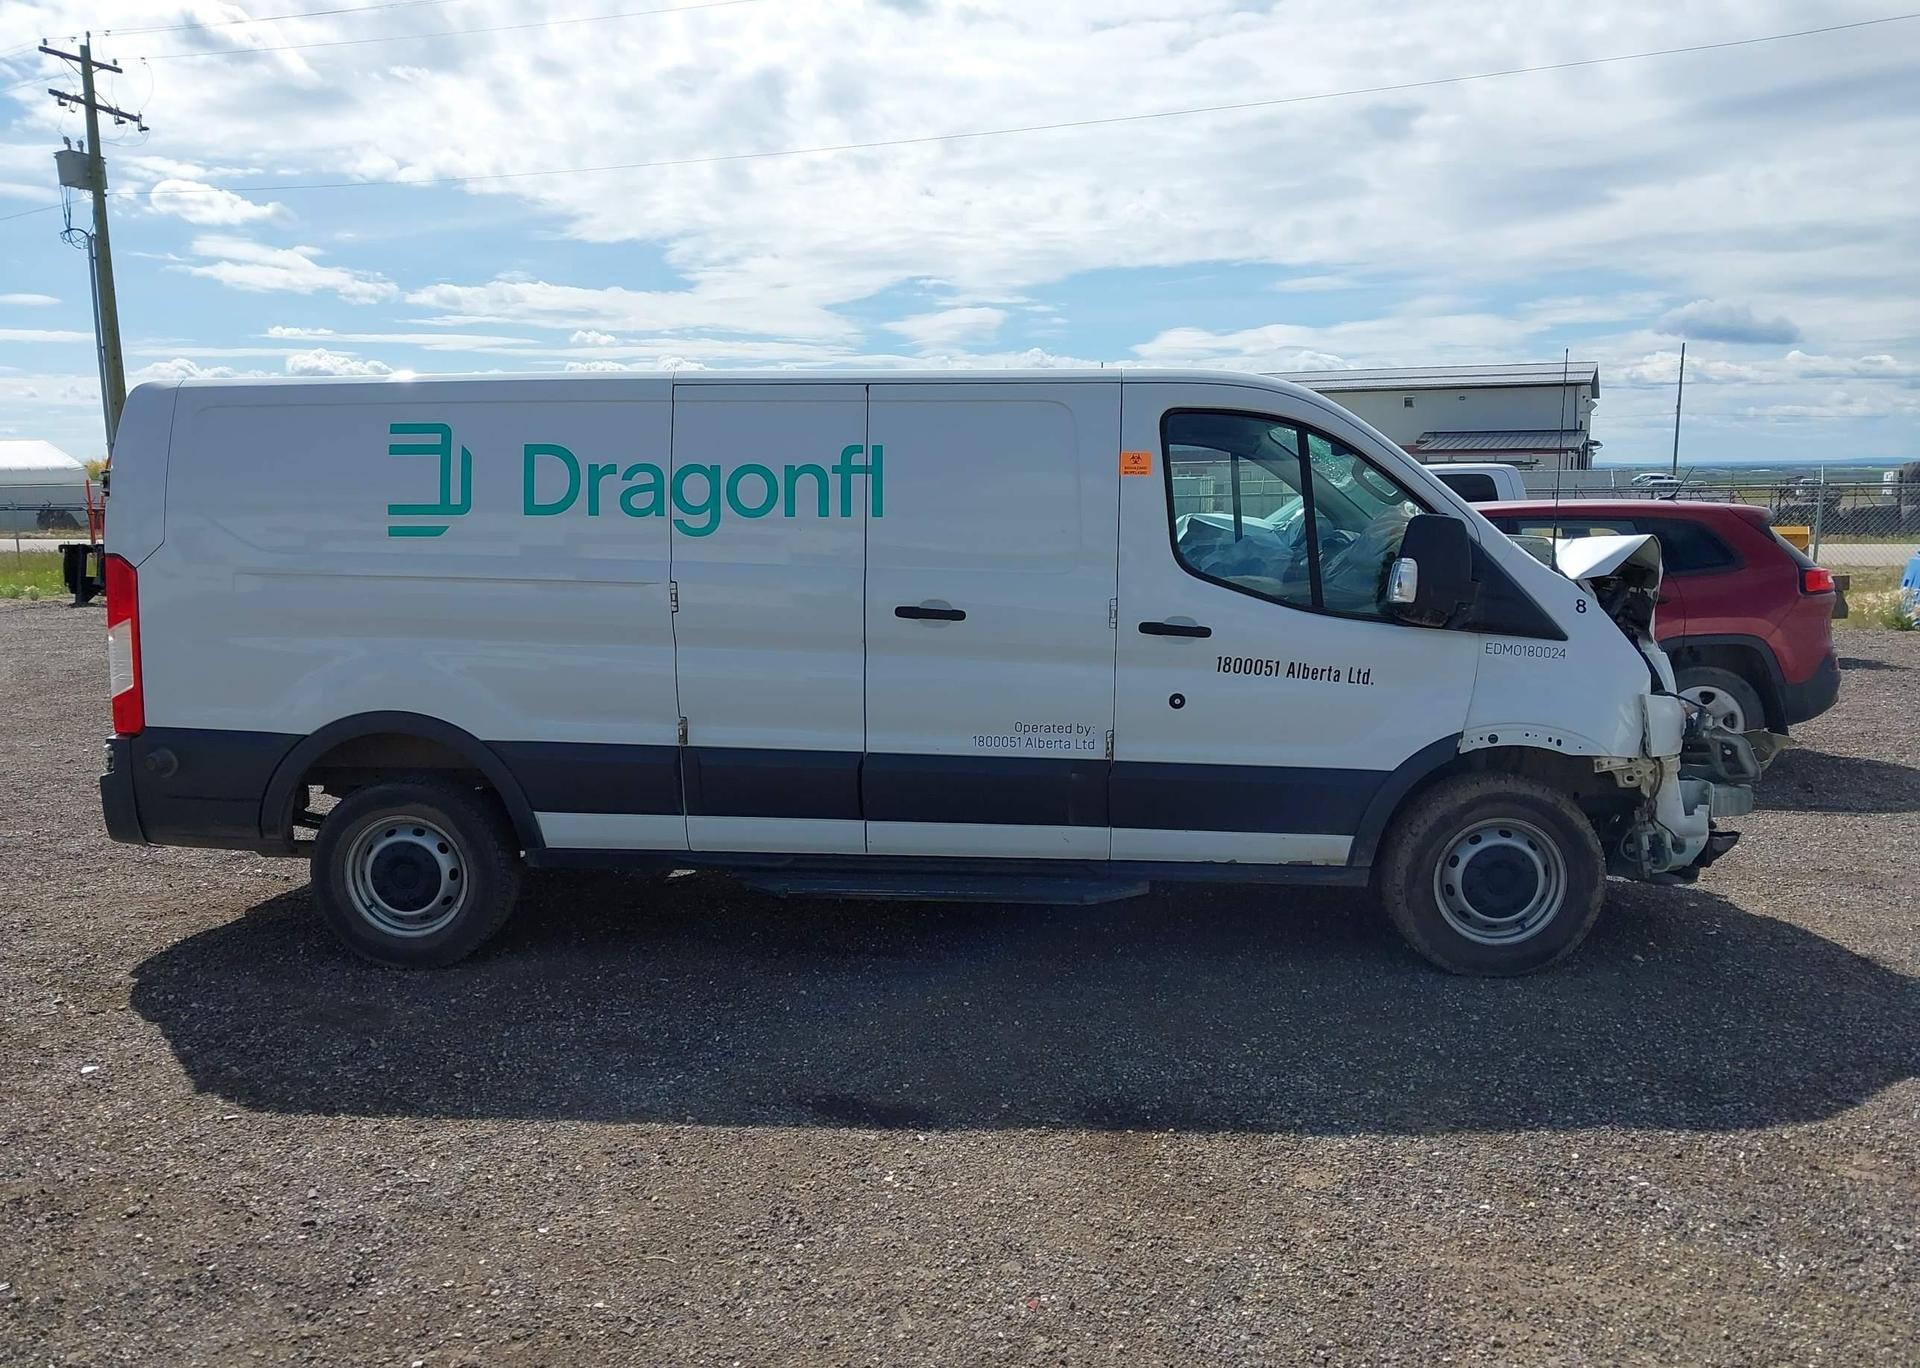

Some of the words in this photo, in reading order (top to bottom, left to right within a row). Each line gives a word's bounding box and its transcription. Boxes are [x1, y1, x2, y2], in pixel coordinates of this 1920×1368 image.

[523, 443, 884, 537] Dragonfl
[1575, 598, 1587, 613] 8
[1216, 656, 1280, 677] 1800051
[1286, 661, 1341, 683] Alberta
[1347, 666, 1375, 686] Ltd.
[1014, 721, 1072, 735] Operated
[1076, 723, 1095, 737] by:
[972, 735, 1021, 748] 1800051
[1025, 737, 1071, 750] Alberta
[1075, 738, 1095, 750] Ltd
